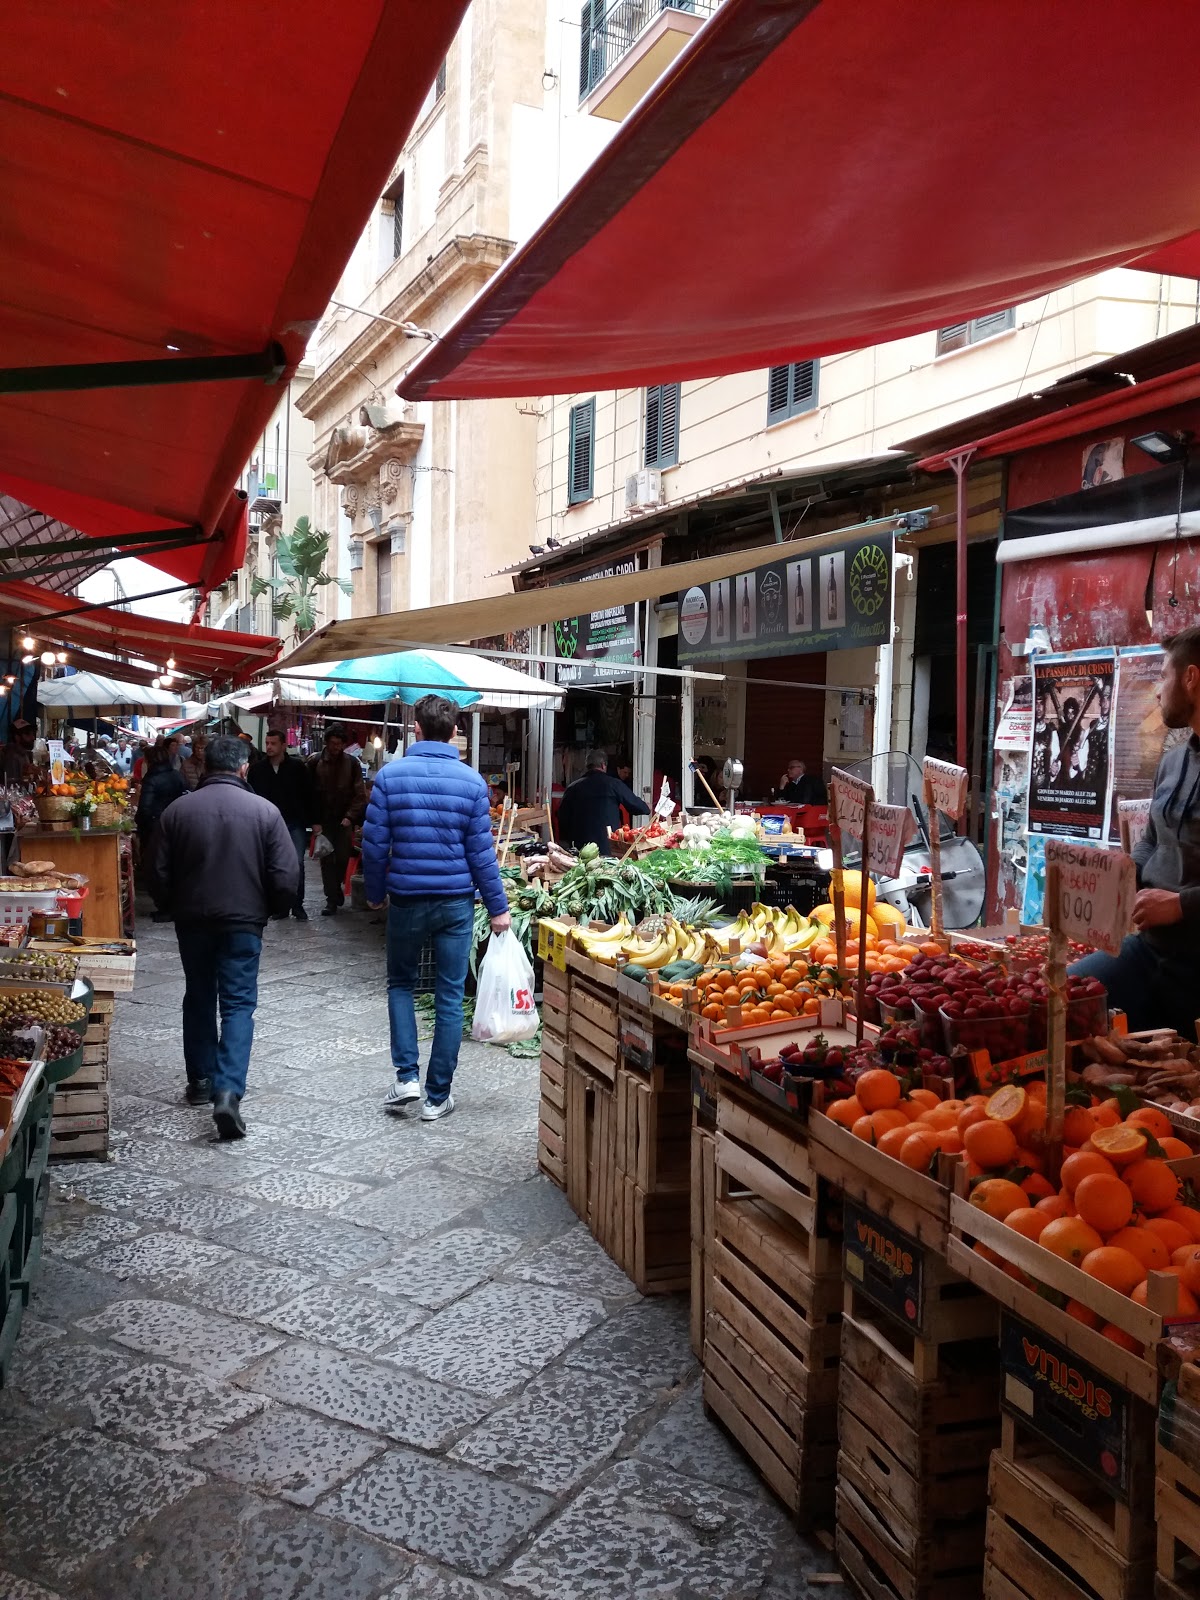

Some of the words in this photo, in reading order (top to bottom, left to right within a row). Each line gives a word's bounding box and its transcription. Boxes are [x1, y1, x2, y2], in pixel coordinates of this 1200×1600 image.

[1036, 668, 1045, 678] LA
[1046, 663, 1077, 677] PASSIONE
[1079, 664, 1087, 676] DI
[1088, 662, 1114, 675] CRISTO
[1022, 1336, 1112, 1418] SICILIA
